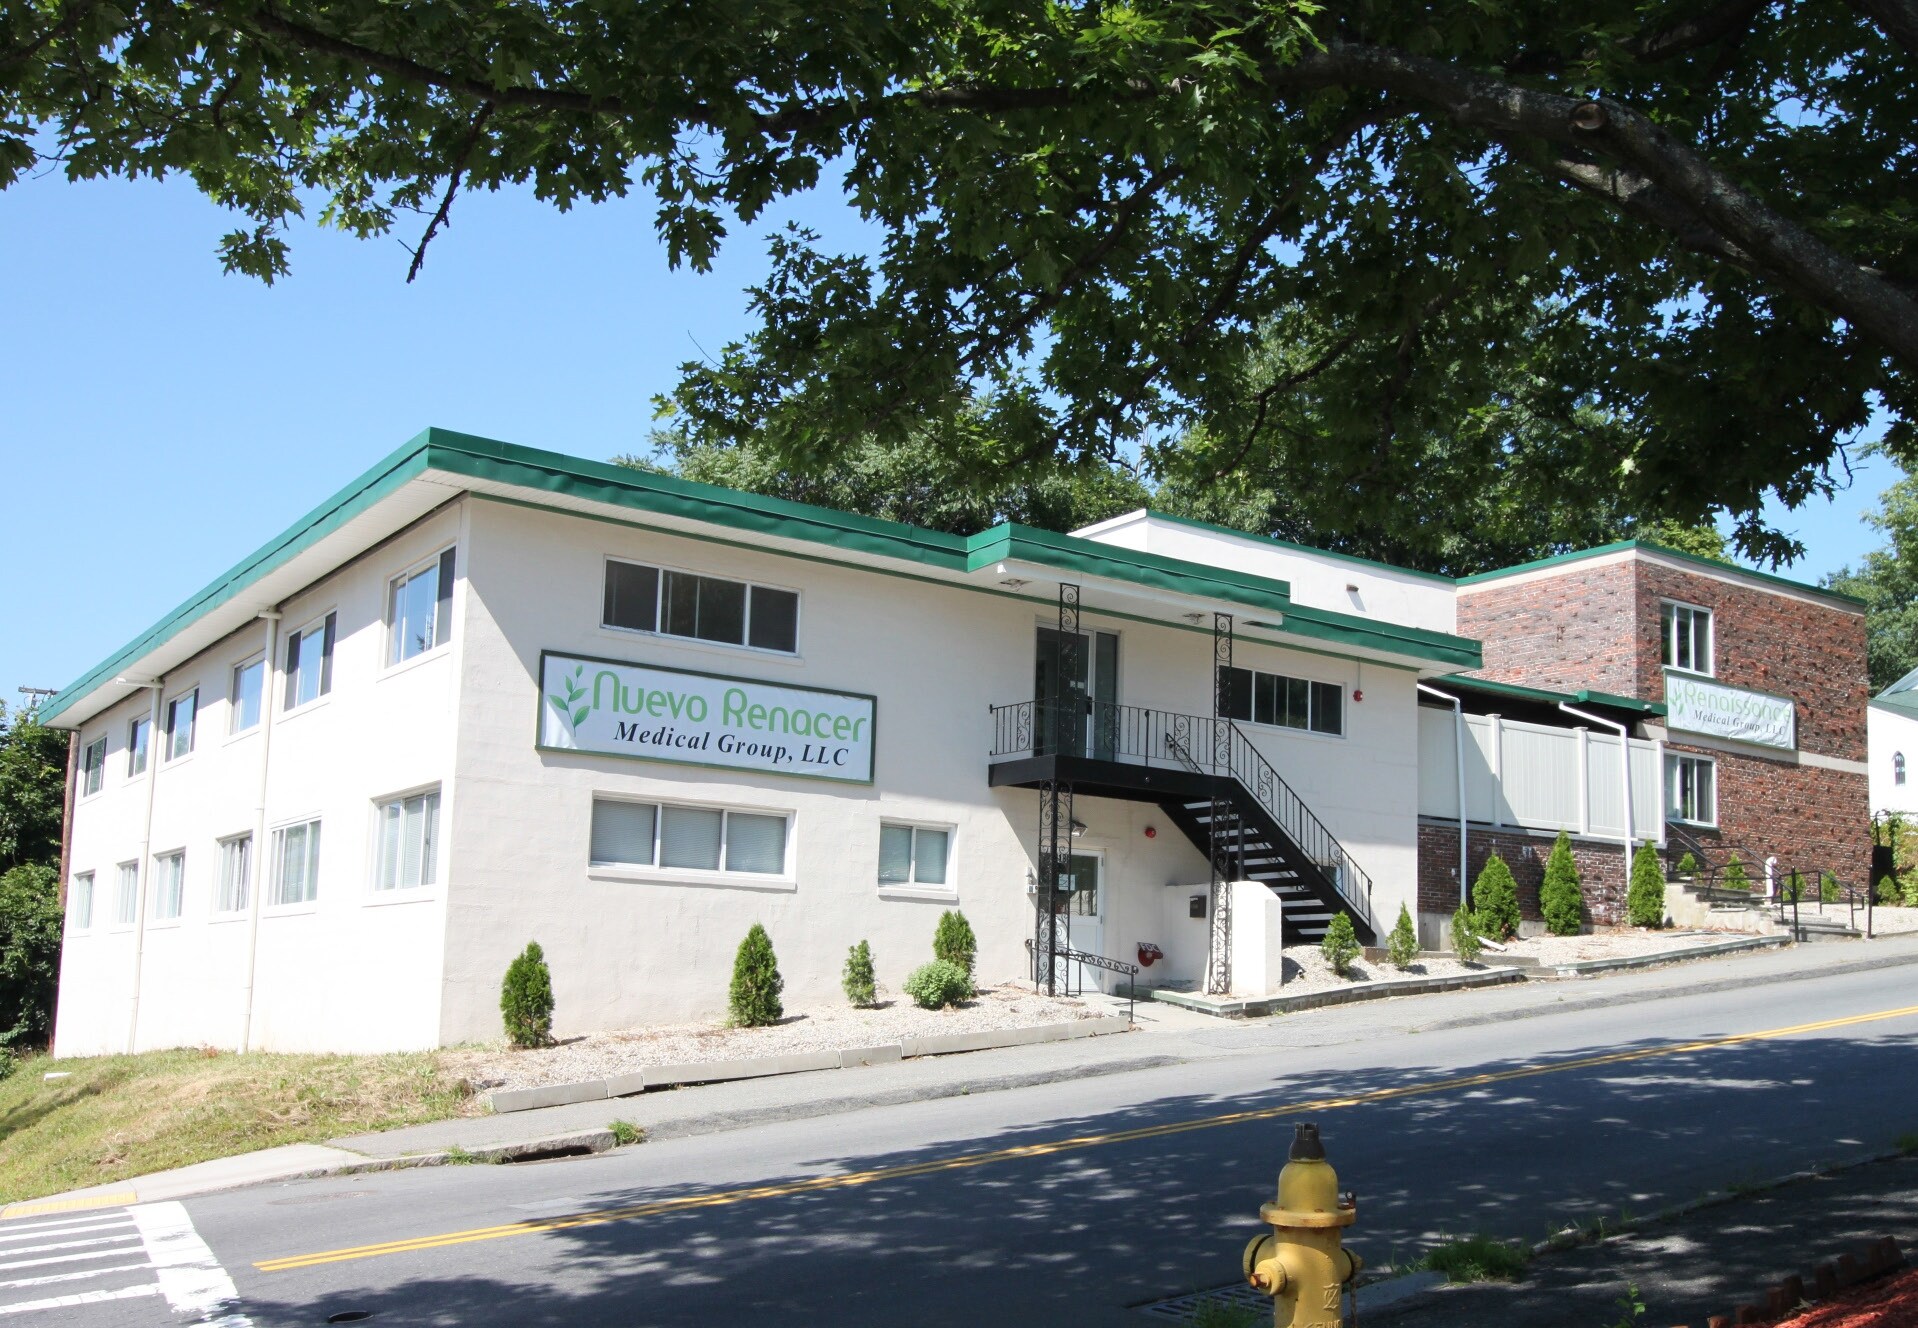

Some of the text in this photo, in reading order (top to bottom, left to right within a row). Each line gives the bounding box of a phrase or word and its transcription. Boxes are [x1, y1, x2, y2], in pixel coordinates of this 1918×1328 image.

[722, 687, 867, 742] Renacer
[1684, 681, 1791, 721] Renaissance
[1694, 709, 1730, 726] Medical
[614, 721, 849, 766] Medical Group, LLC
